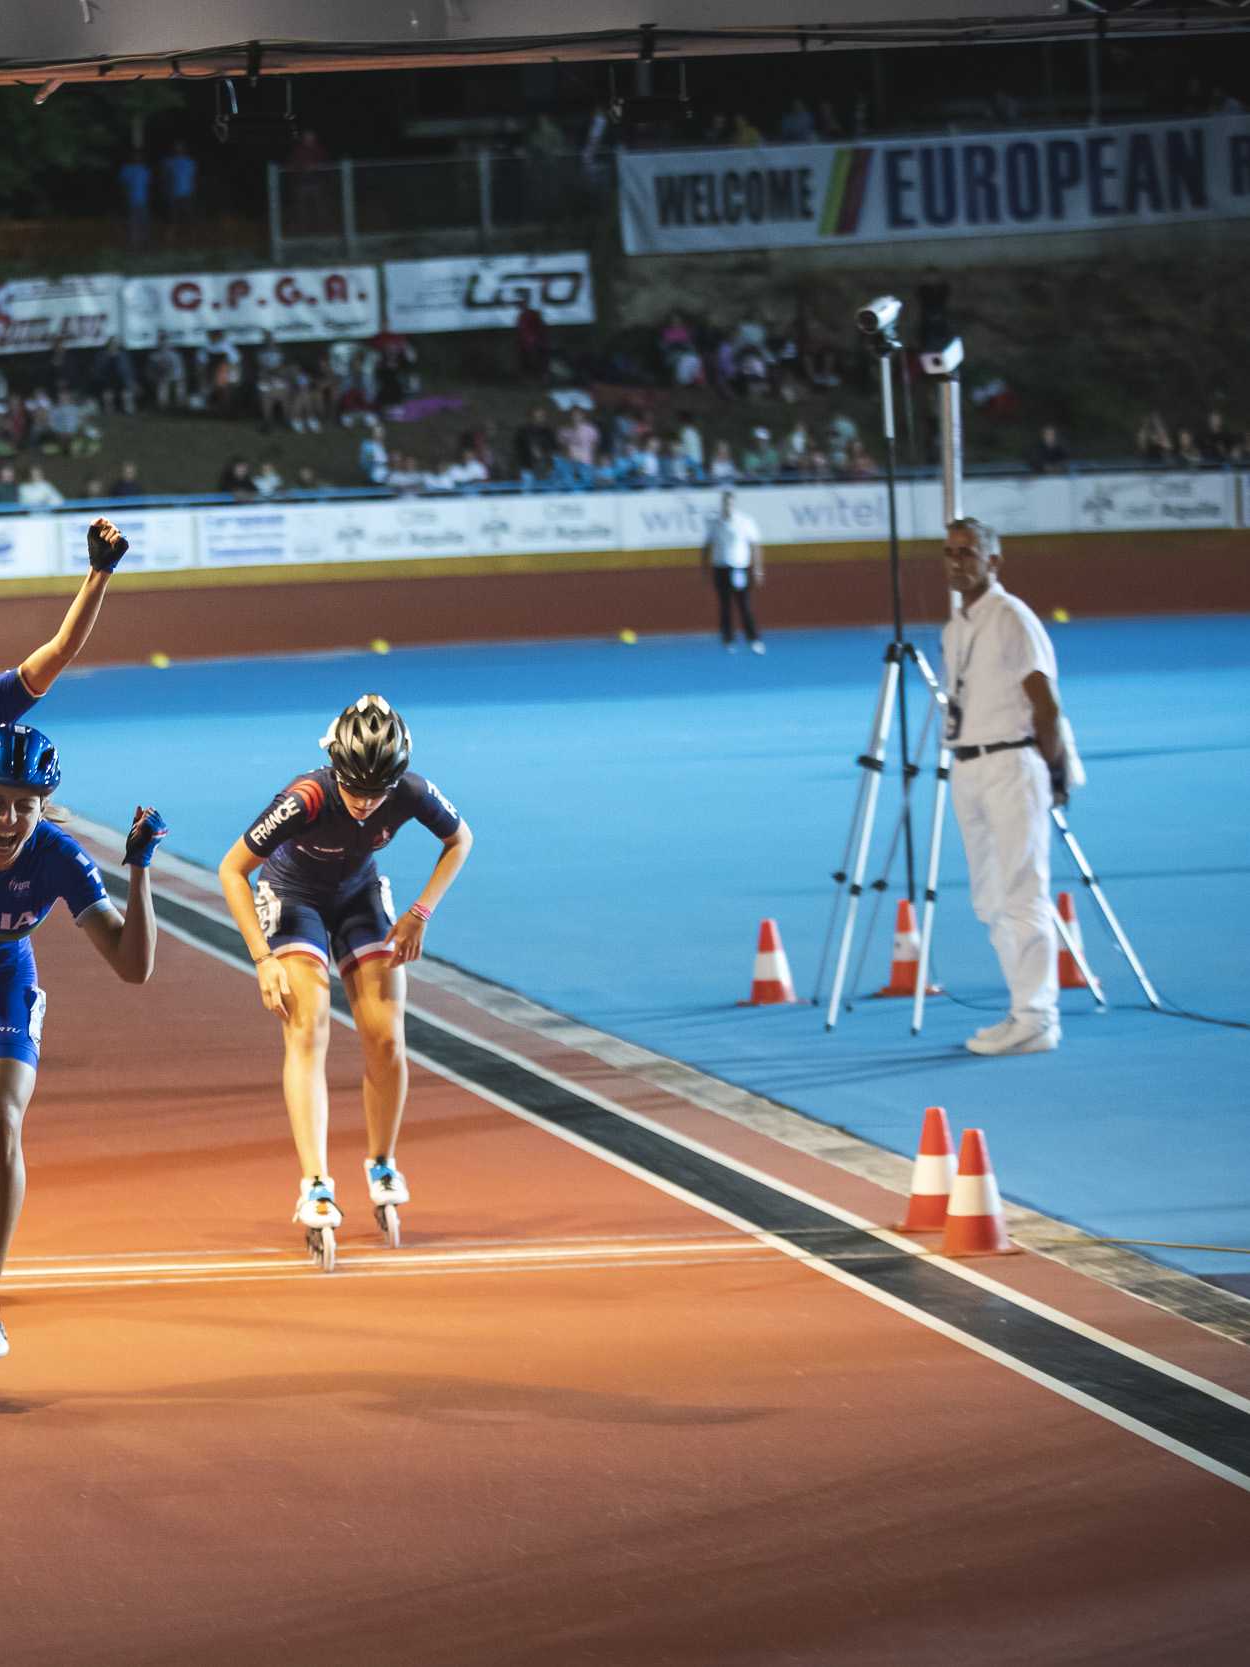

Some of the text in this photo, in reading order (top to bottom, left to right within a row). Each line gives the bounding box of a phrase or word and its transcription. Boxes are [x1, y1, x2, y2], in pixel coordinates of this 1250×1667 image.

[652, 168, 816, 227] WELCOME
[882, 128, 1210, 230] EUROPEAN
[249, 796, 301, 847] FRANCE
